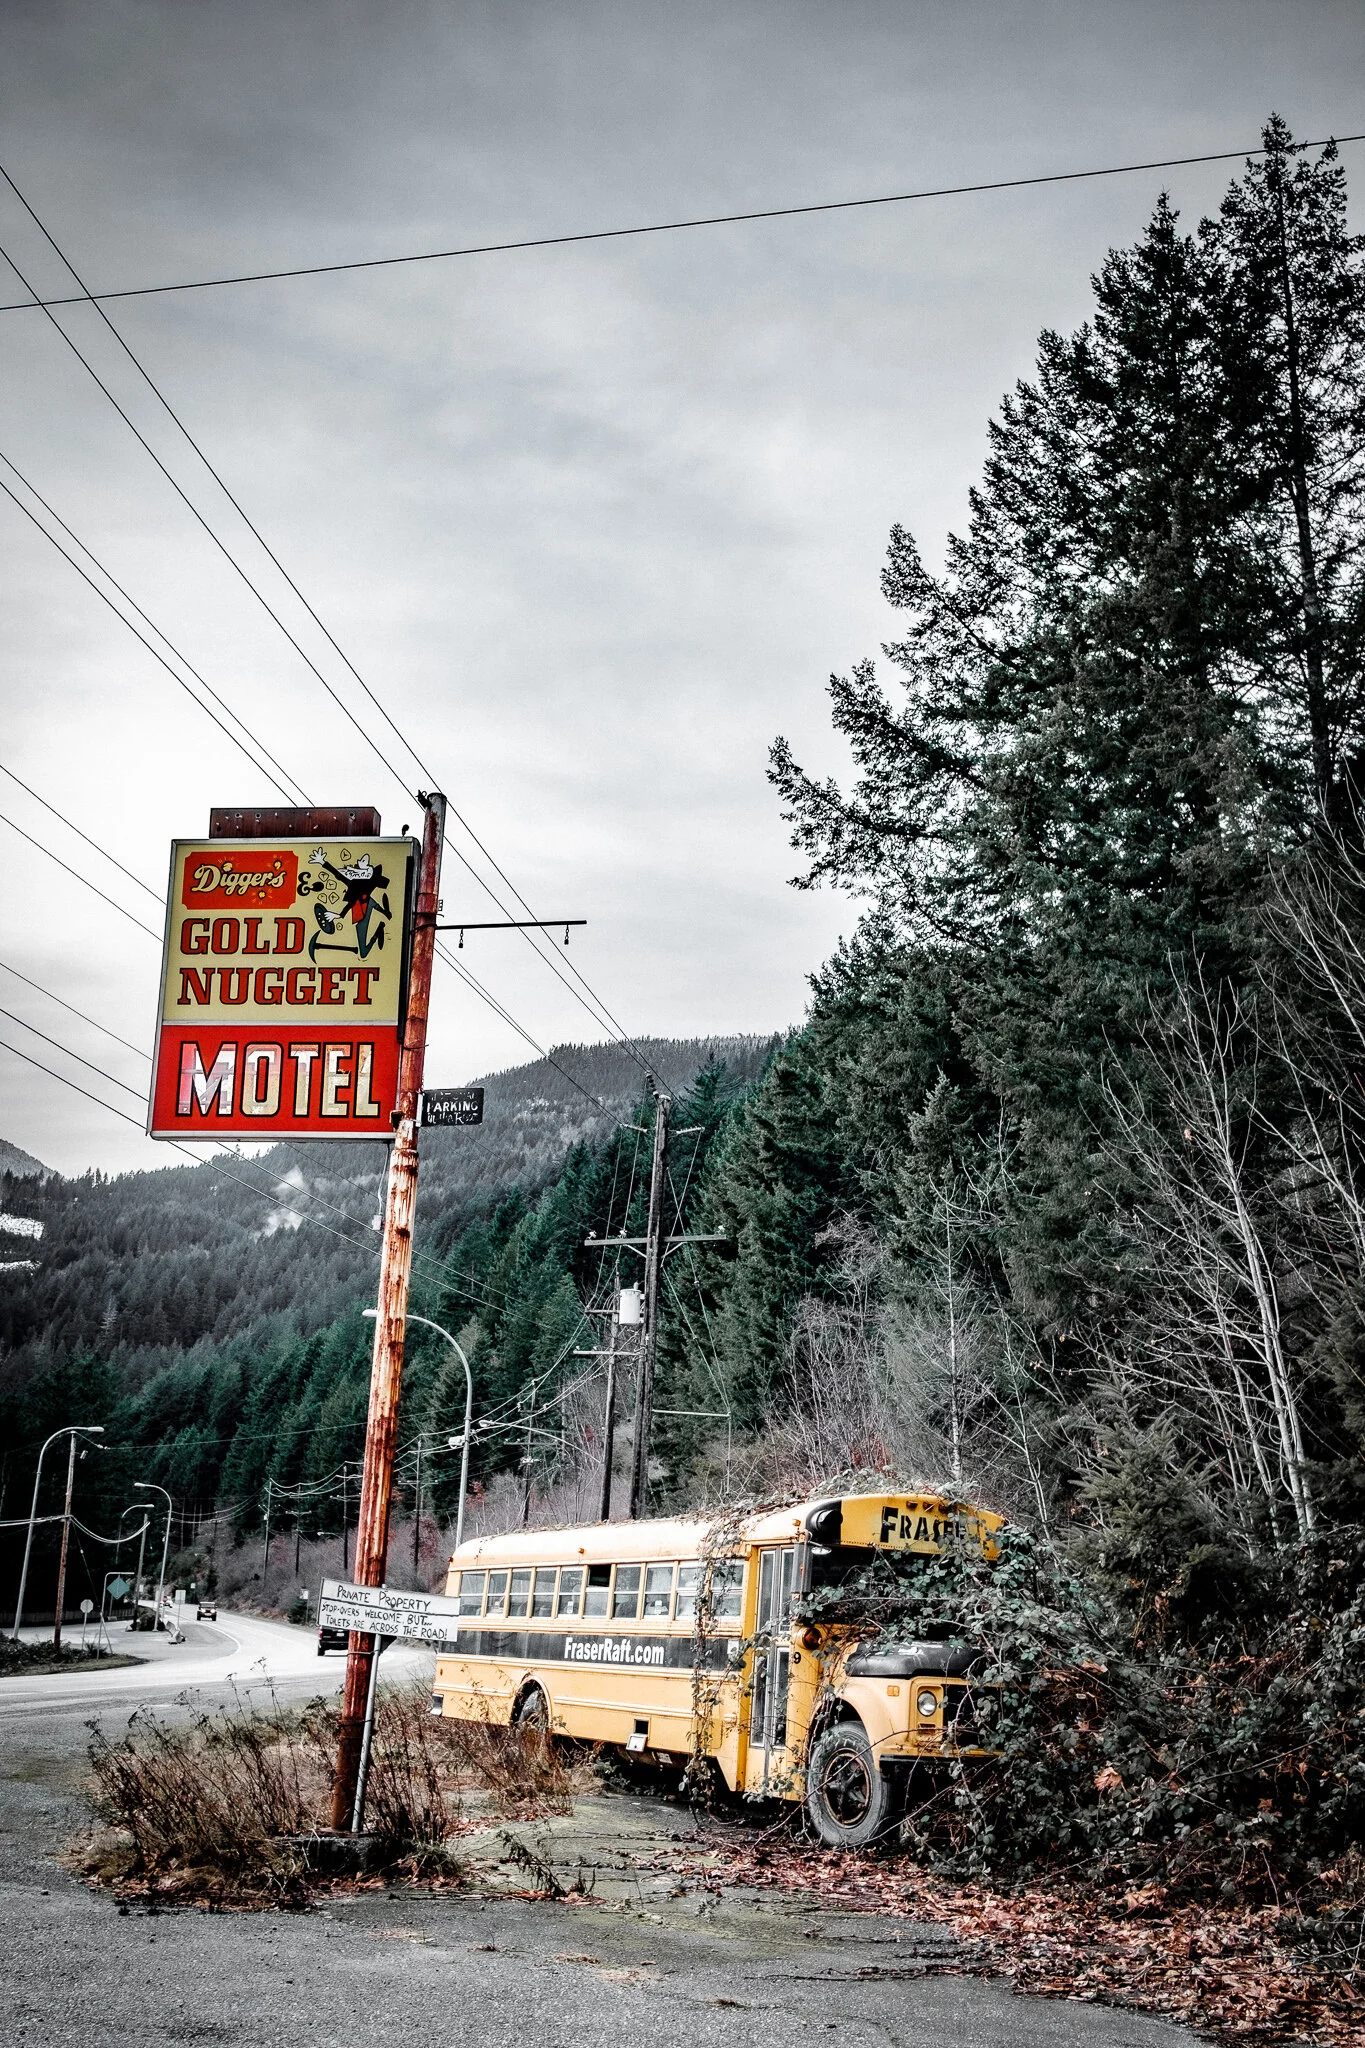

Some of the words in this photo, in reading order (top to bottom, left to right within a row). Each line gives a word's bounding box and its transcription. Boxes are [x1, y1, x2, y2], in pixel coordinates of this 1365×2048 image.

[190, 859, 287, 896] Digger's
[297, 871, 325, 897] &
[179, 916, 306, 955] GOLD
[176, 967, 381, 1006] NUGGET
[175, 1040, 381, 1119] MOTEL
[403, 1625, 418, 1637] THE
[421, 1627, 448, 1640] ROAD!
[564, 1636, 665, 1665] FraserRaft.com
[793, 1651, 802, 1665] 9
